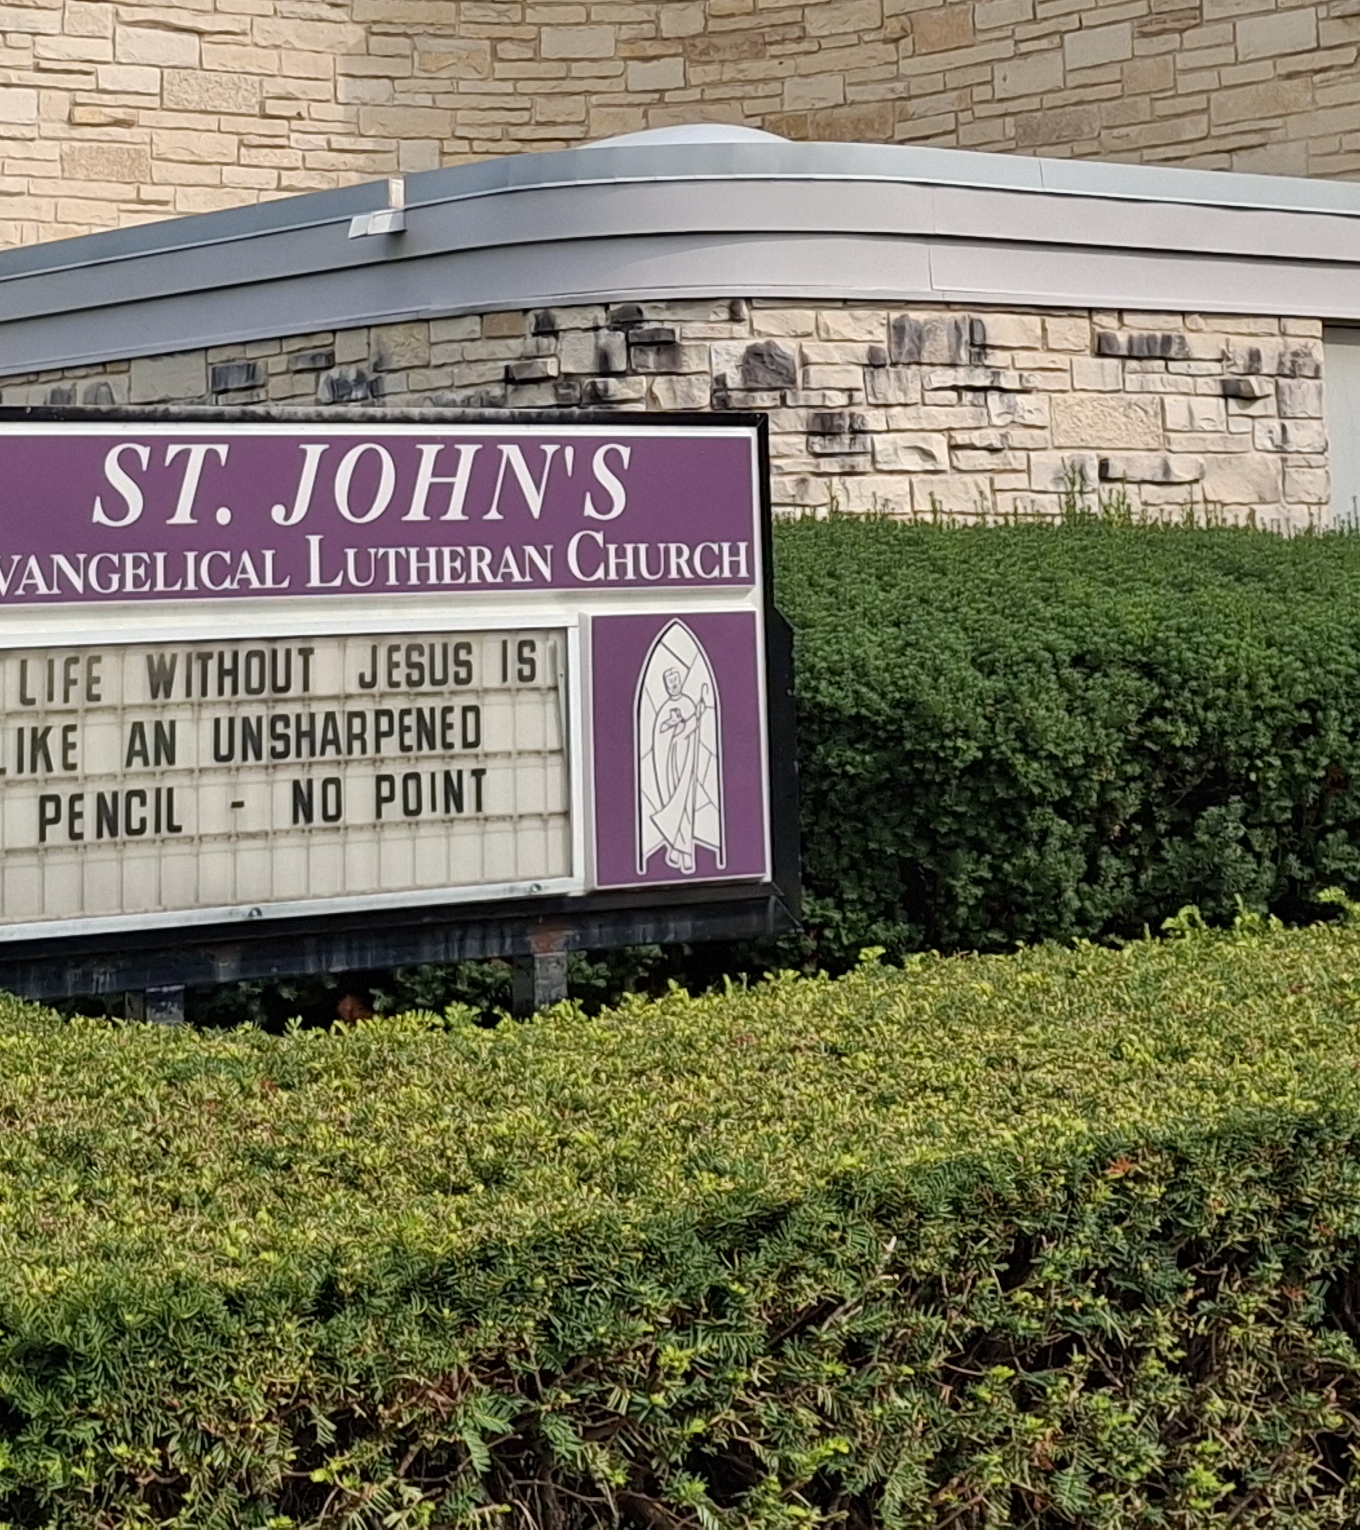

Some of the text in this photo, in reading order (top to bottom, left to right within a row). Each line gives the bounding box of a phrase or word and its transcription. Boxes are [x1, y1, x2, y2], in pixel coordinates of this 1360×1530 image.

[91, 442, 633, 528] ST. JOHN'S
[19, 640, 537, 705] LIFE WITHOUT JESUS IS
[125, 719, 178, 768] AN
[213, 705, 482, 762] UNSHARPENED
[38, 787, 183, 842] PENCIL
[291, 776, 342, 825] NO
[374, 768, 488, 819] POINT
